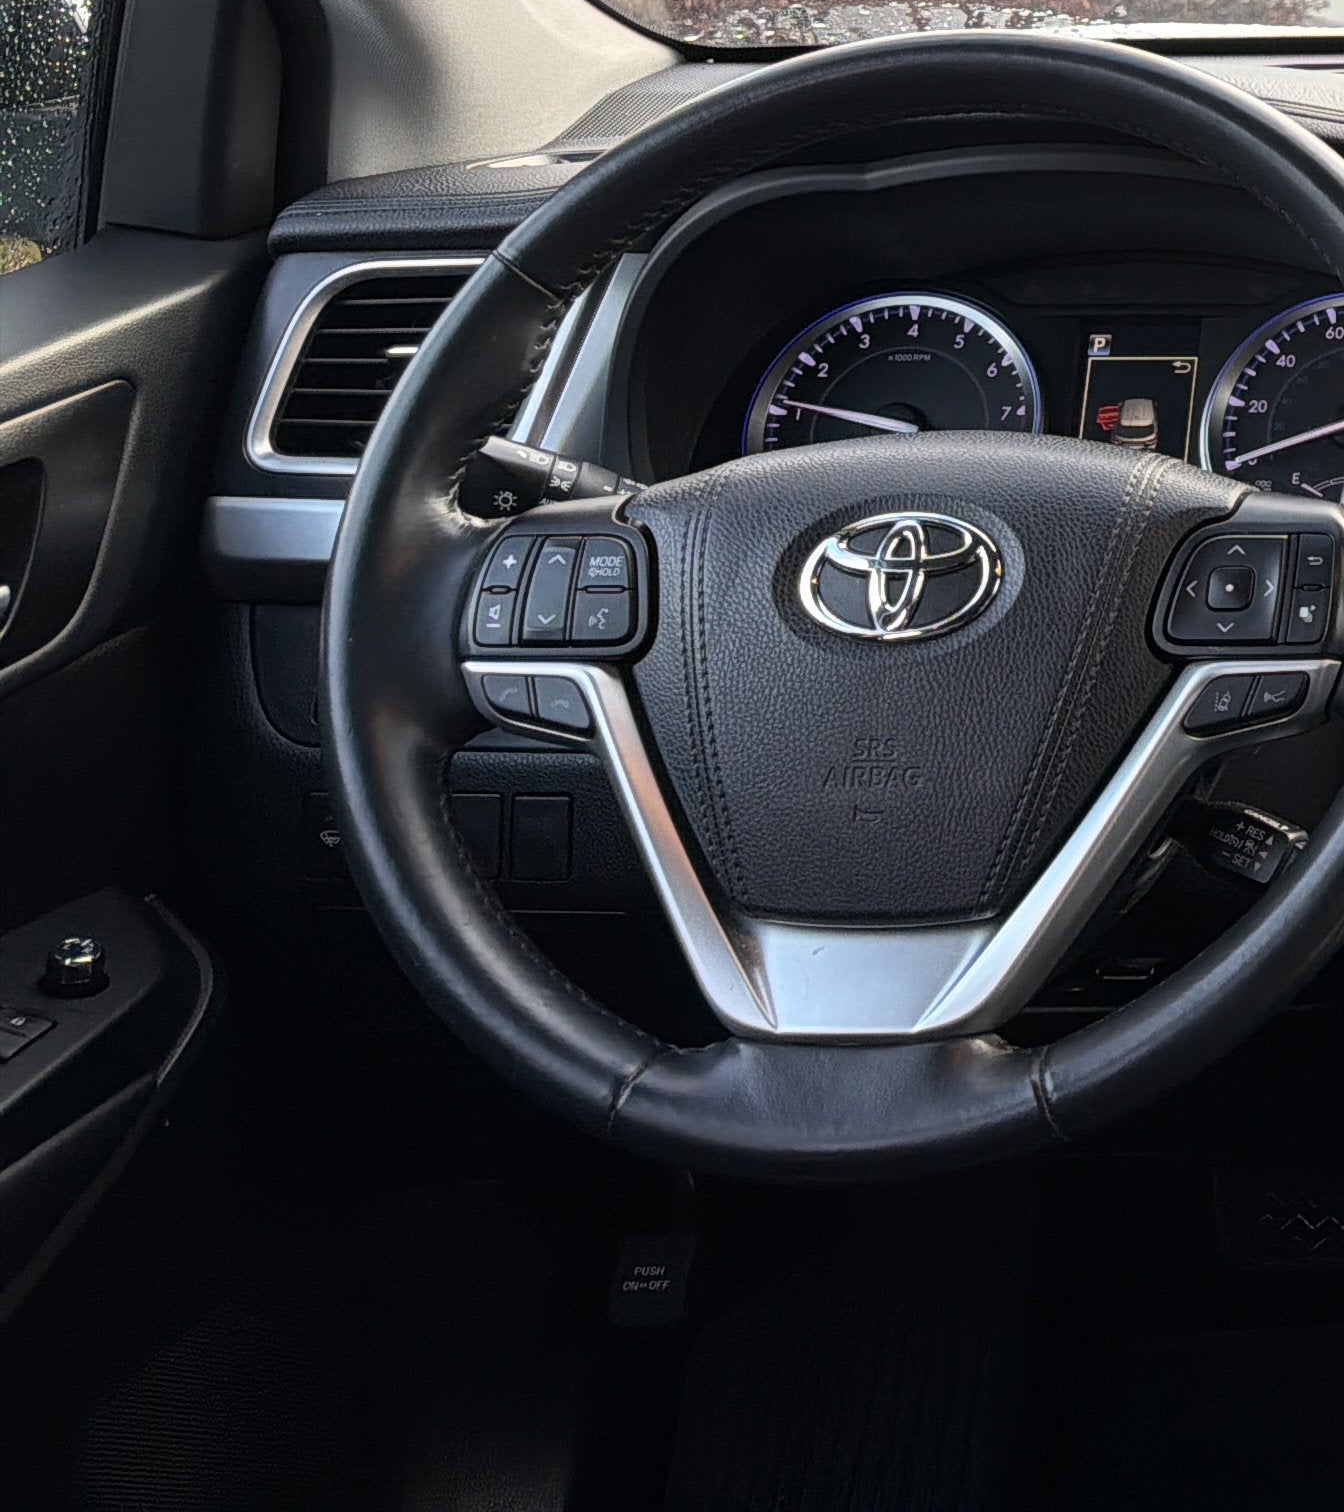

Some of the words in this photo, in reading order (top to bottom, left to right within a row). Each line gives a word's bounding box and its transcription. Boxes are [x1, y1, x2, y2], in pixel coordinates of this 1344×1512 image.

[908, 325, 919, 338] 4
[1325, 326, 1344, 339] 60
[859, 334, 870, 349] 3
[954, 334, 965, 349] 5
[1094, 337, 1106, 353] P
[1276, 354, 1296, 368] 40
[817, 364, 828, 377] 2
[987, 365, 998, 377] 6
[1248, 399, 1268, 413] 20
[1000, 406, 1011, 421] 7
[1292, 472, 1301, 485] E
[589, 556, 624, 567] MODE
[853, 738, 898, 759] SRS
[822, 766, 924, 788] AIRBAG
[1246, 825, 1266, 841] RES
[1231, 853, 1251, 867] SET
[634, 1266, 665, 1276] PUSH
[622, 1281, 639, 1291] ON
[648, 1280, 670, 1290] OFF
